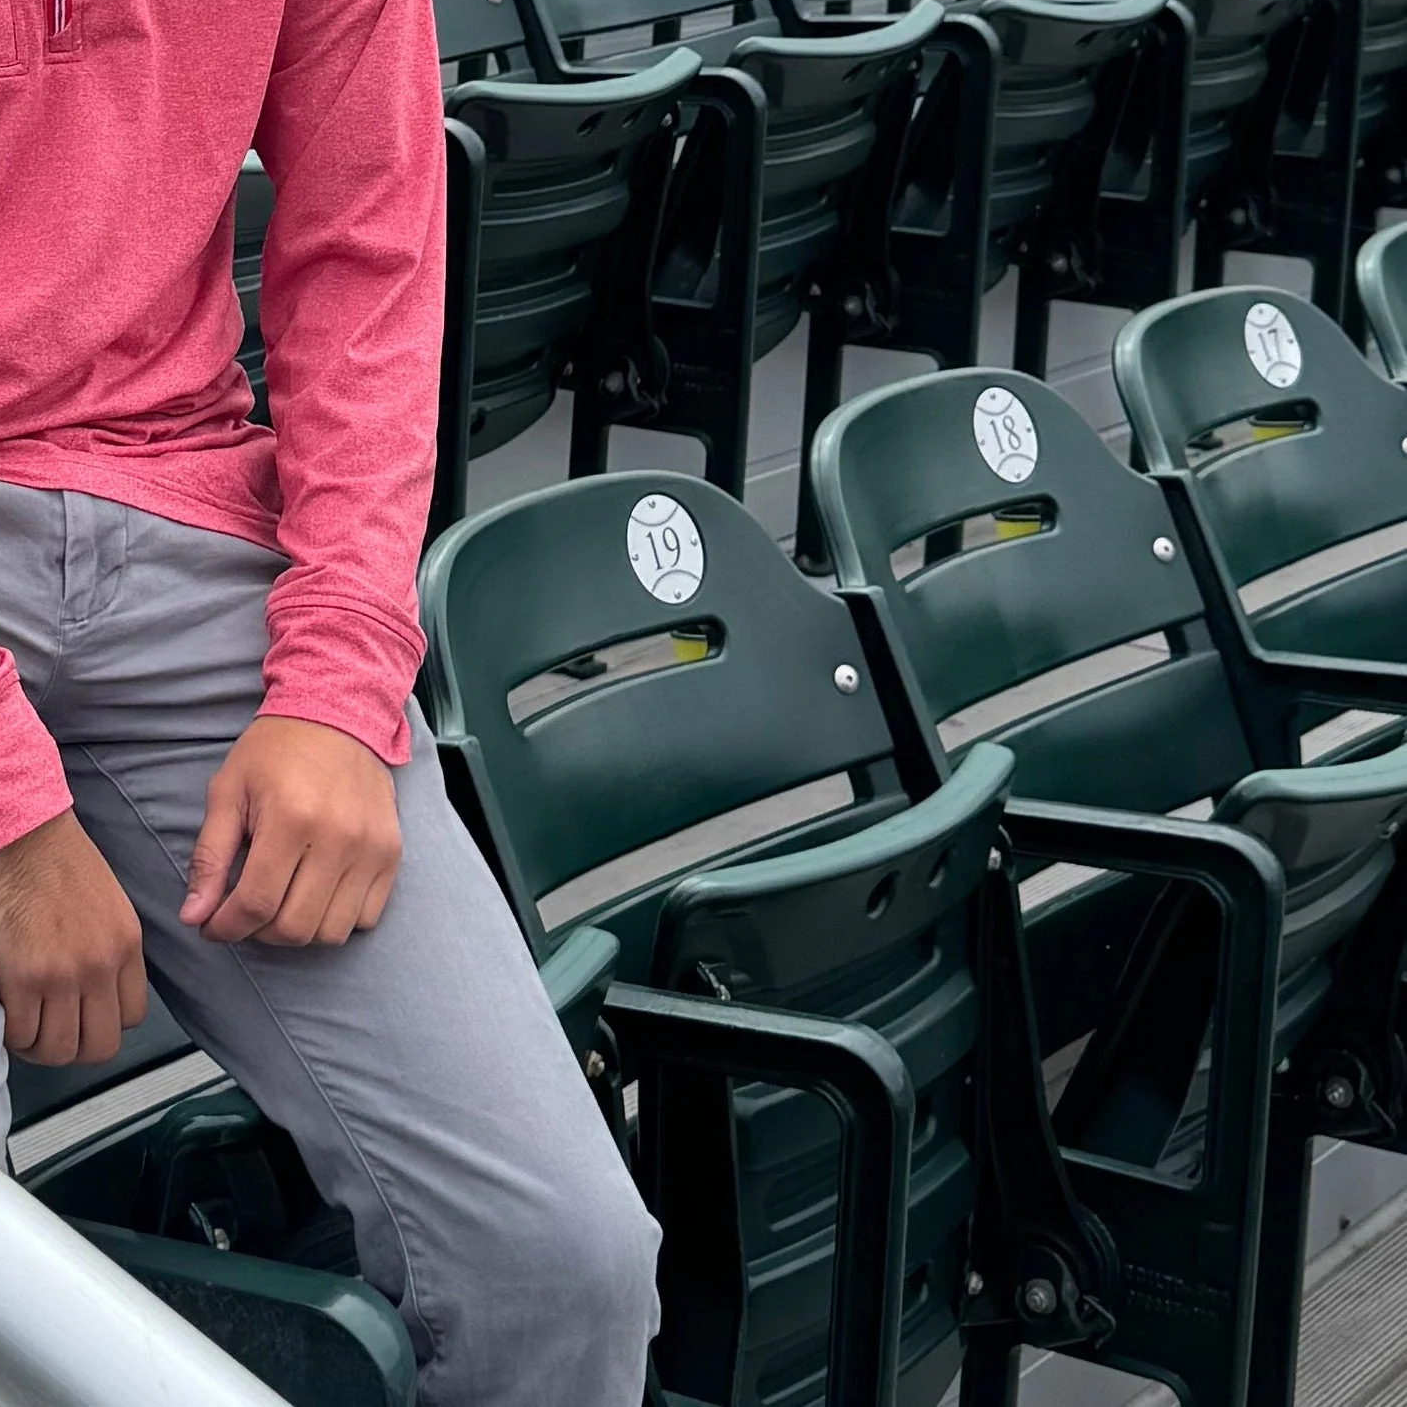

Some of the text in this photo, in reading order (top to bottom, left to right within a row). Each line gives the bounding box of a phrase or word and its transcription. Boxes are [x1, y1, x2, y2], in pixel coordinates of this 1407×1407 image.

[1258, 328, 1280, 363] 17
[990, 415, 1021, 453] 18
[646, 527, 680, 569] 19
